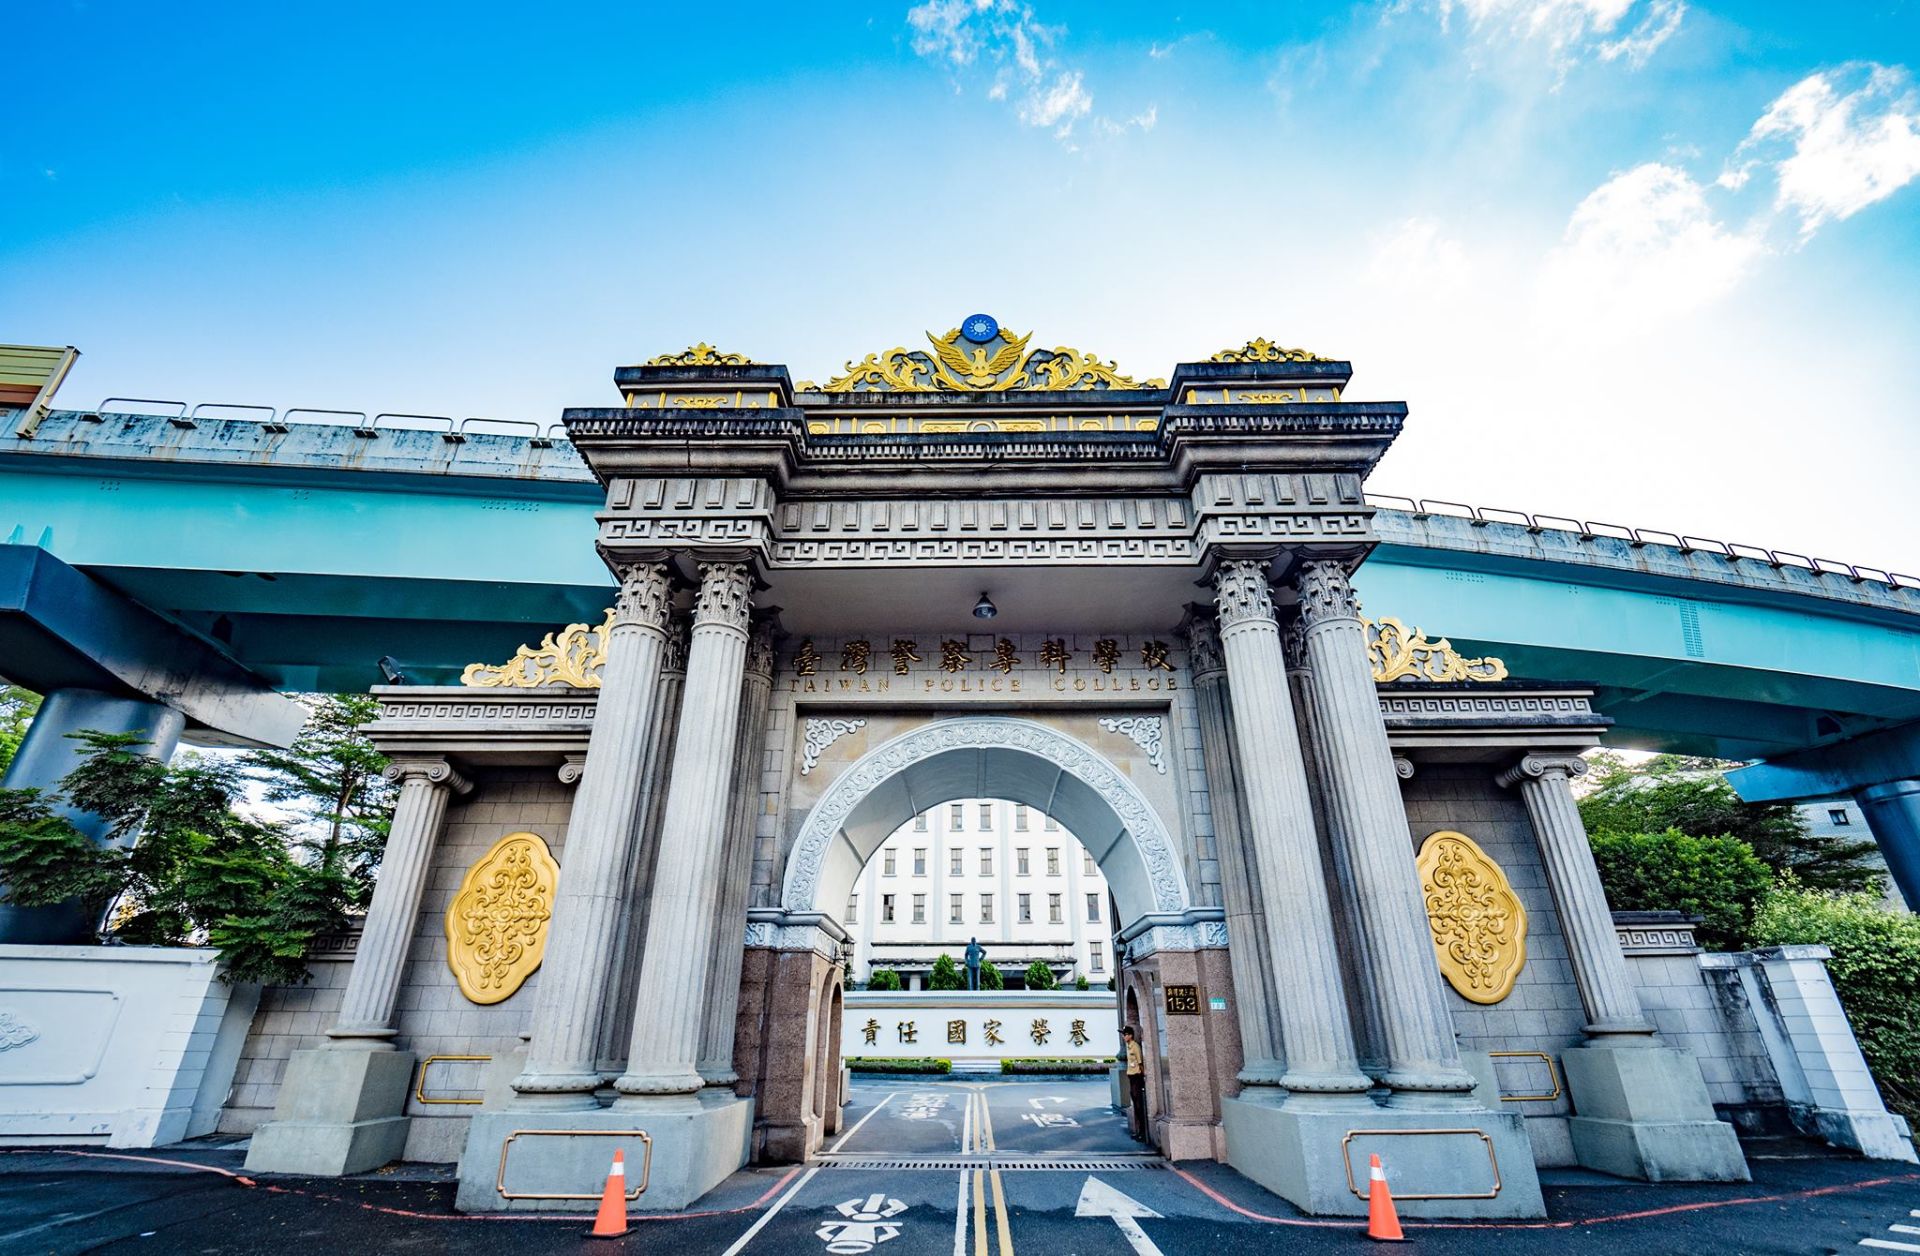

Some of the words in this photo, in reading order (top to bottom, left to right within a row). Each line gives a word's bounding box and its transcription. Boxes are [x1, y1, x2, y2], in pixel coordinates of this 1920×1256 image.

[793, 639, 1178, 675] 臺灣警察專科學校
[789, 678, 889, 692] TAIWAN
[925, 678, 1022, 692] POLICE
[1054, 677, 1178, 691] COLLEGE
[1168, 998, 1195, 1011] 153
